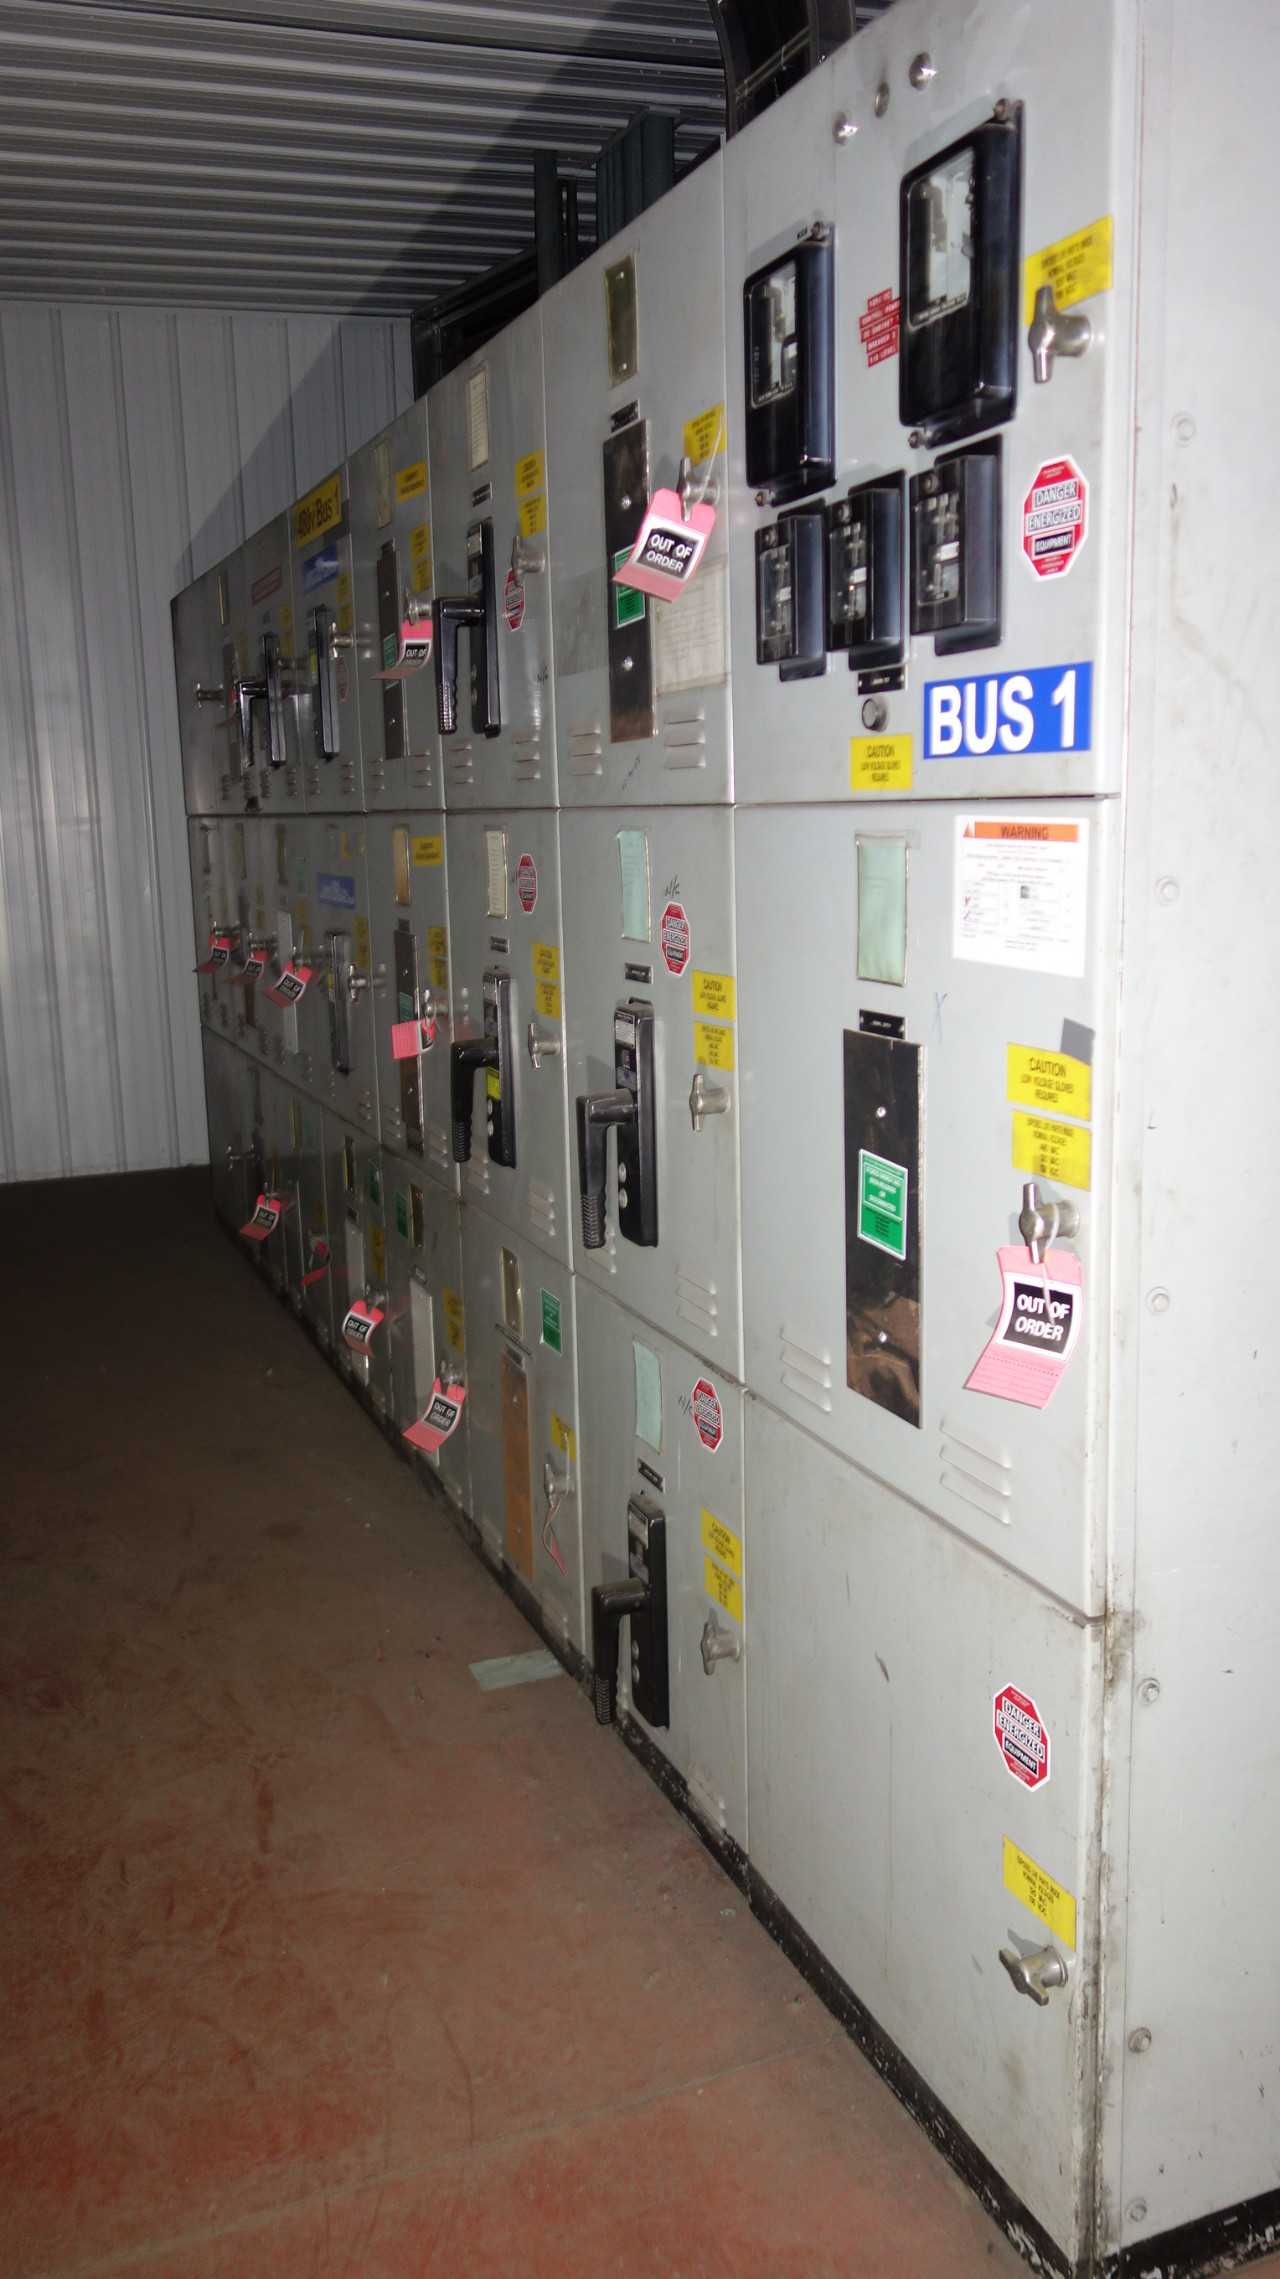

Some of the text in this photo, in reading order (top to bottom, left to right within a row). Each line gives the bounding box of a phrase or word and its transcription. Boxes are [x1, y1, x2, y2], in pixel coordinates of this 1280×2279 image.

[1035, 481, 1077, 508] DANGER
[1028, 503, 1081, 532] ENERGIZED
[651, 534, 693, 558] OUT OF
[647, 550, 684, 573] ORDER
[929, 670, 1076, 755] BUS 1
[1000, 826, 1048, 840] WARNING
[1029, 1057, 1066, 1077] CAUTION
[1017, 1294, 1070, 1319] OUT OF
[1015, 1316, 1063, 1341] ORDER
[1004, 1699, 1041, 1738] DANGER
[998, 1712, 1044, 1760] ENERGIZED
[1006, 1740, 1037, 1772] EQUIPMENT
